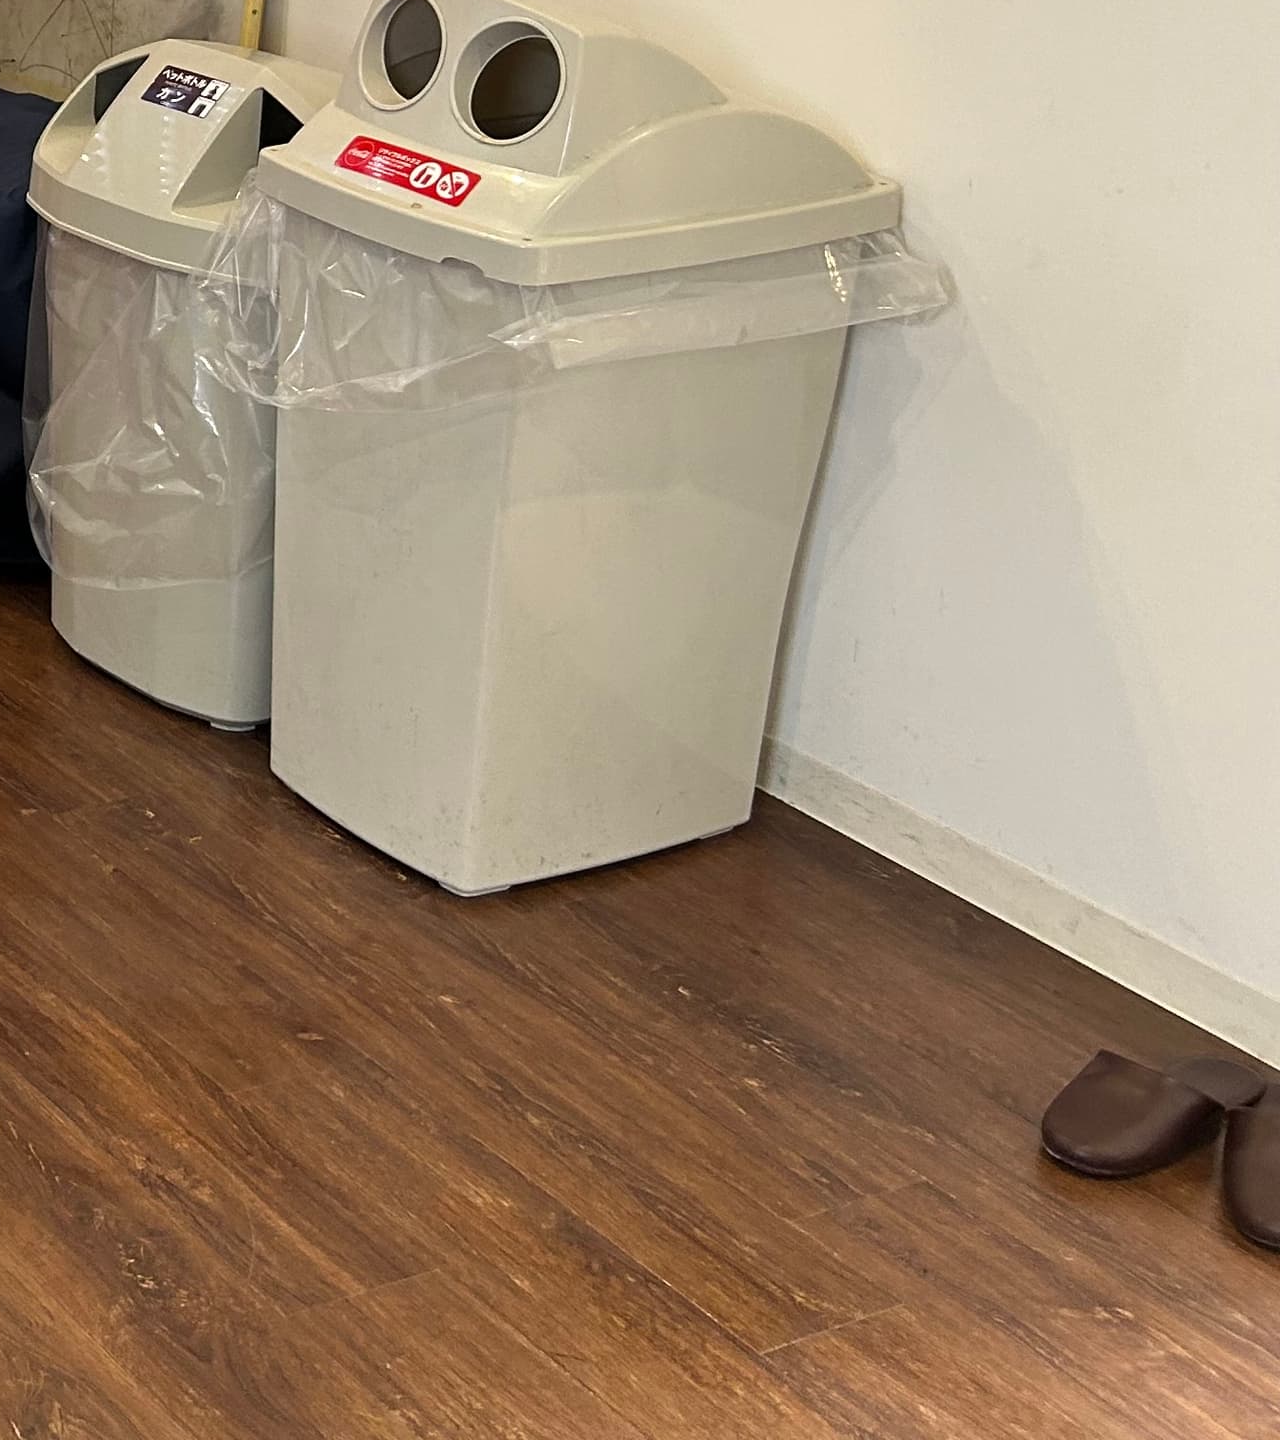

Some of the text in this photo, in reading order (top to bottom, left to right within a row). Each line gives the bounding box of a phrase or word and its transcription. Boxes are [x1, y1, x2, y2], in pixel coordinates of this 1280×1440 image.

[163, 69, 208, 88] ペットボトル
[156, 87, 186, 102] カン
